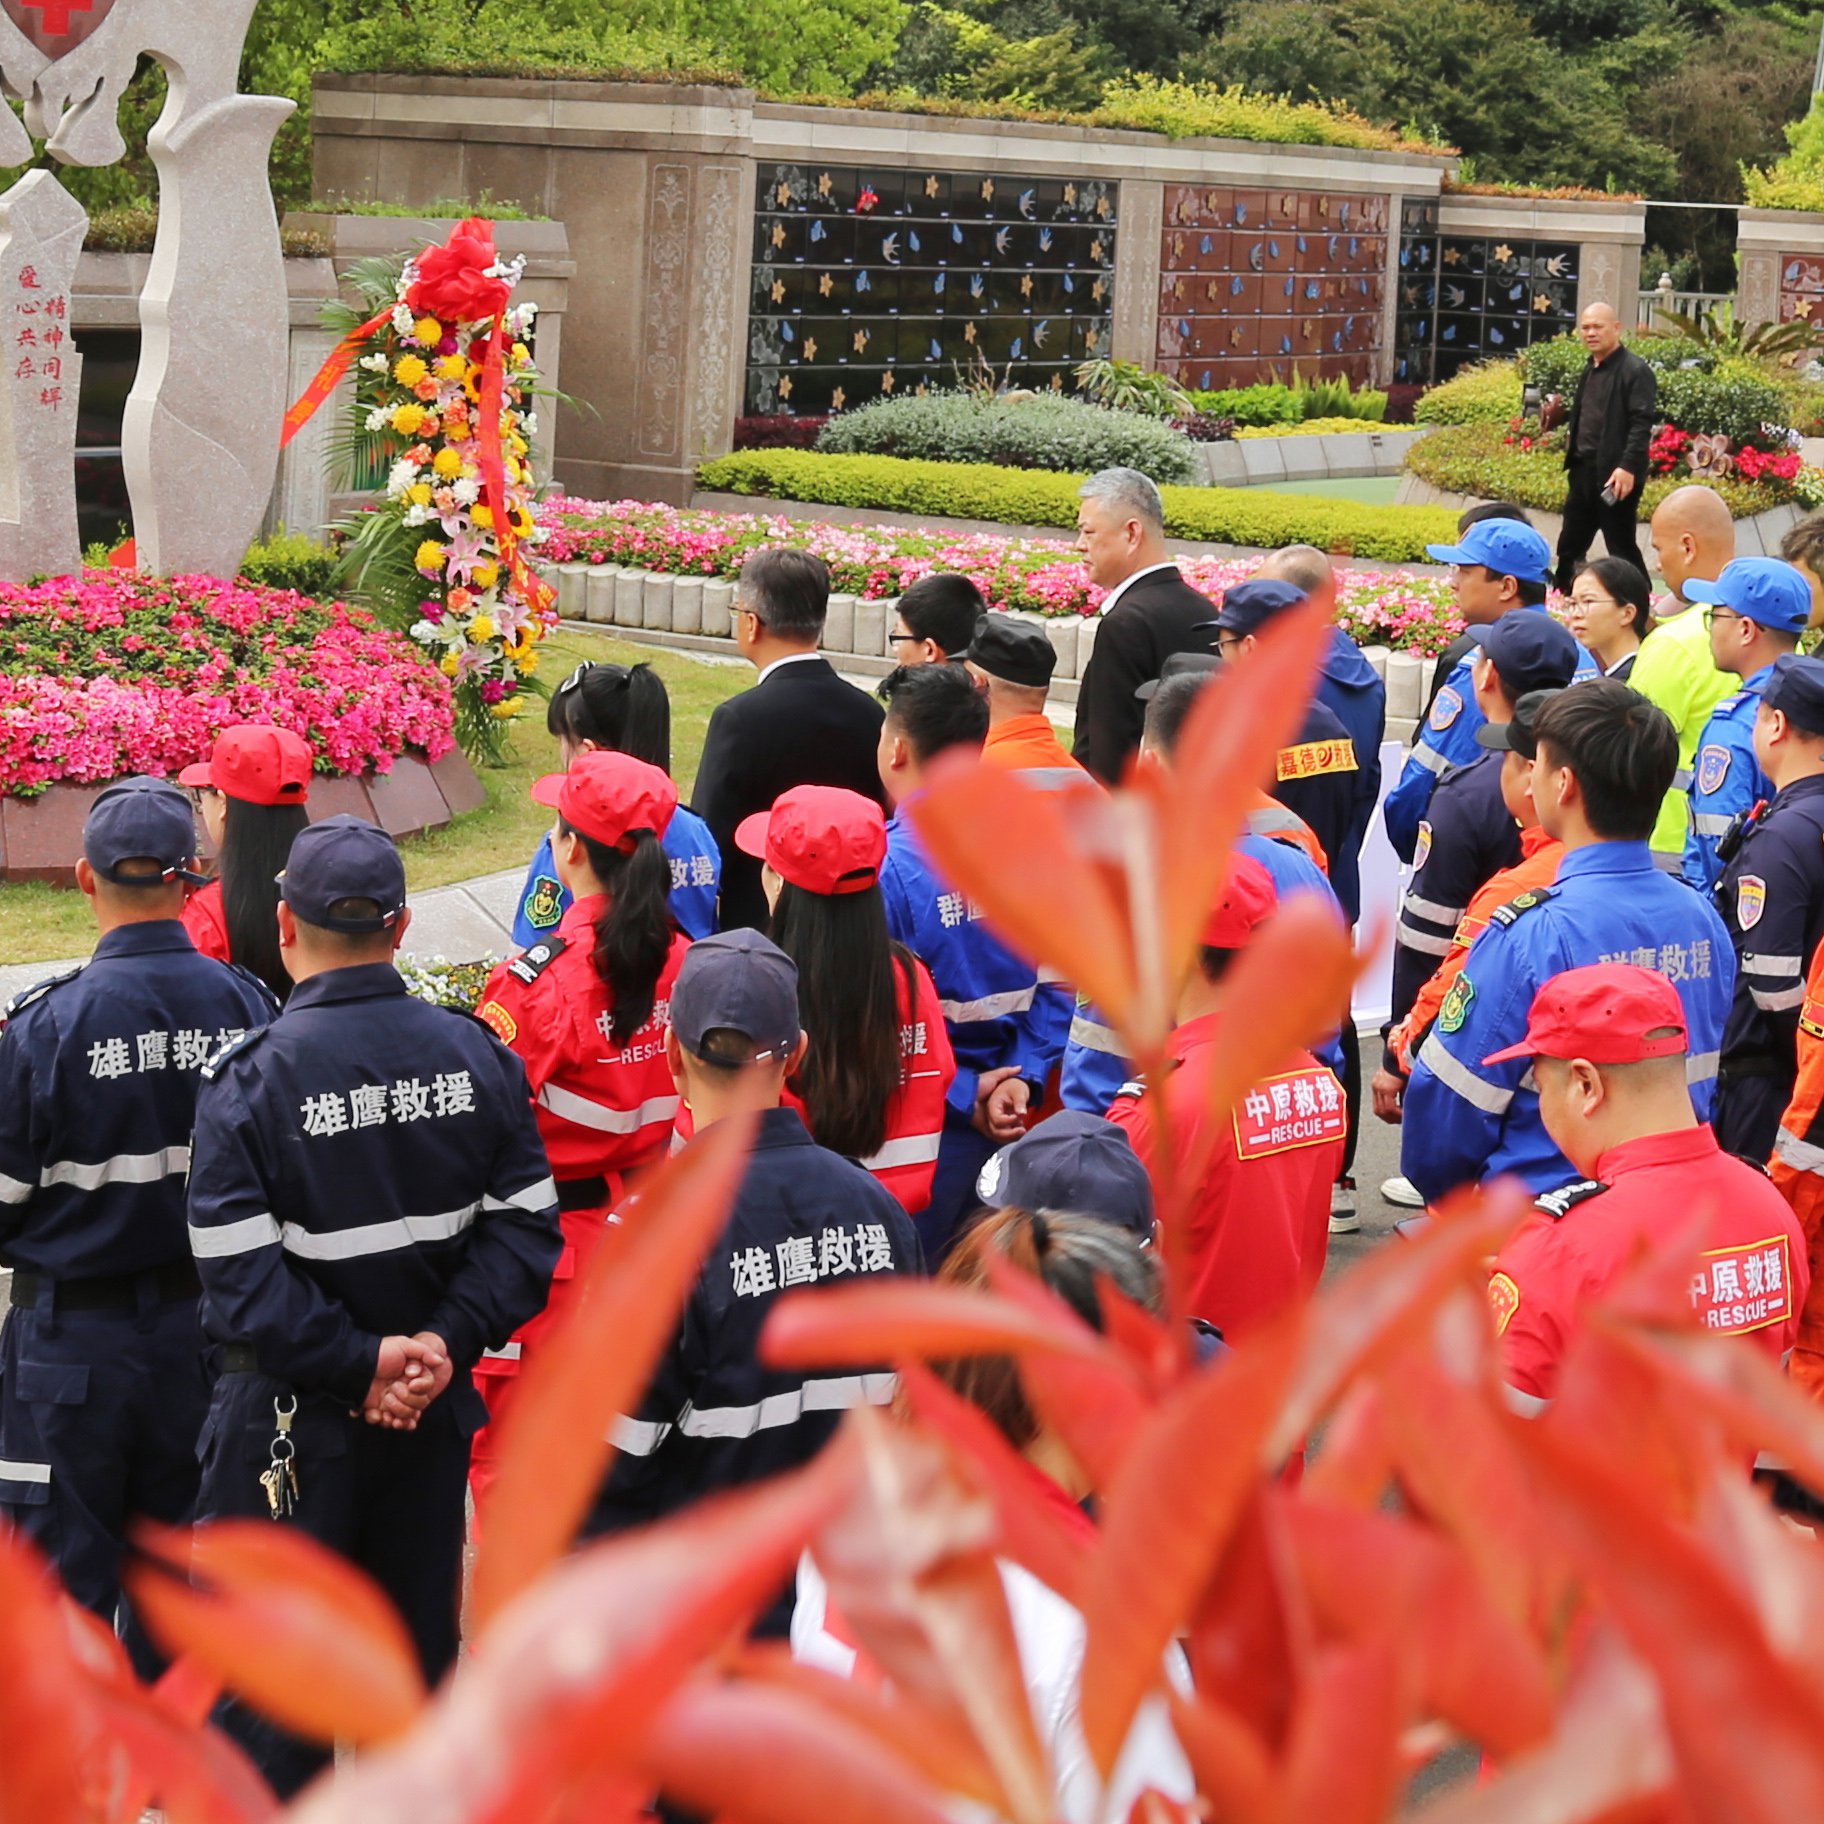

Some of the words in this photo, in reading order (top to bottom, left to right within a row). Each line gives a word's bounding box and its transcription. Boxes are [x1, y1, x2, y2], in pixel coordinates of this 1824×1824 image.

[300, 1069, 476, 1137] 雄鹰救援
[1244, 1075, 1340, 1127] 中原救援
[1271, 1117, 1323, 1145] RESCUE
[729, 1223, 895, 1298] 雄鹰救援
[1707, 1298, 1768, 1329] RESCUE
